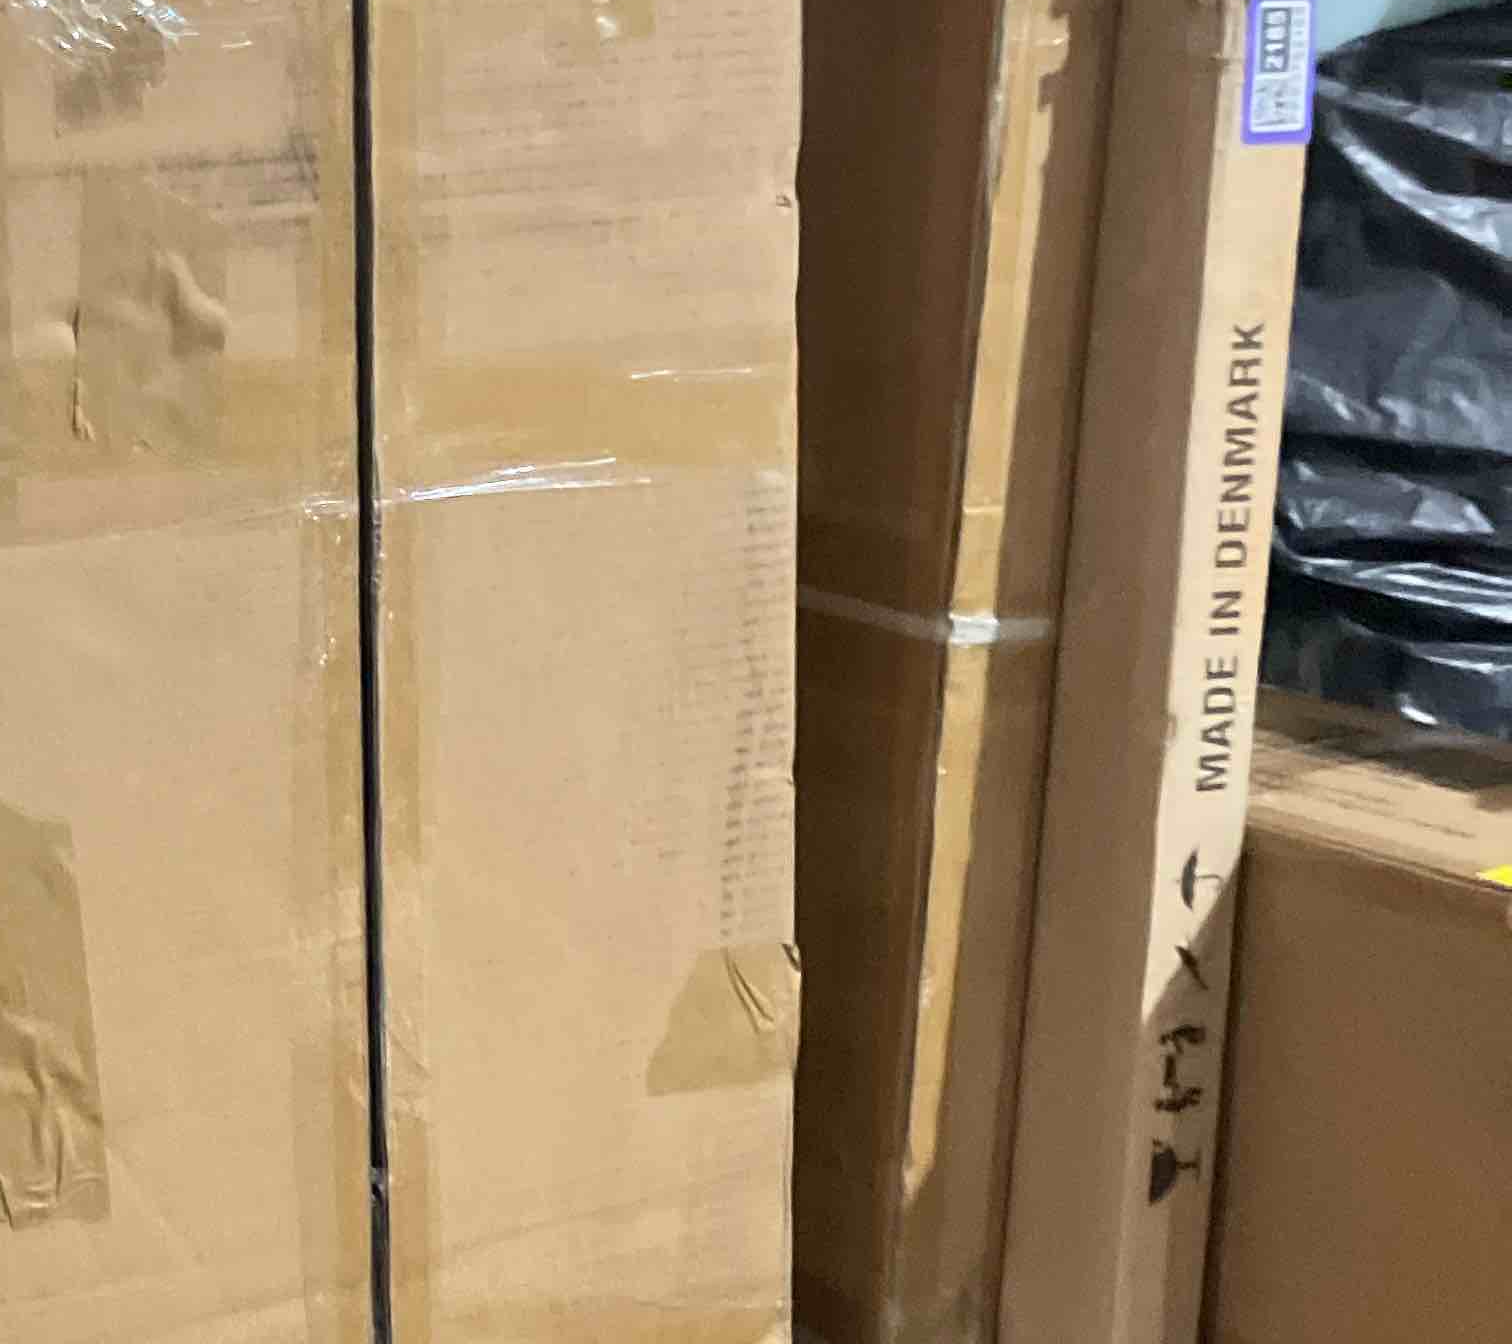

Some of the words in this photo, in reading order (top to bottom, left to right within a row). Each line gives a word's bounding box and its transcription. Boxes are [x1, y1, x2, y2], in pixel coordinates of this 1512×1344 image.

[1216, 322, 1265, 570] DENMARK
[1210, 588, 1242, 637] IN
[1195, 654, 1240, 794] MADE
